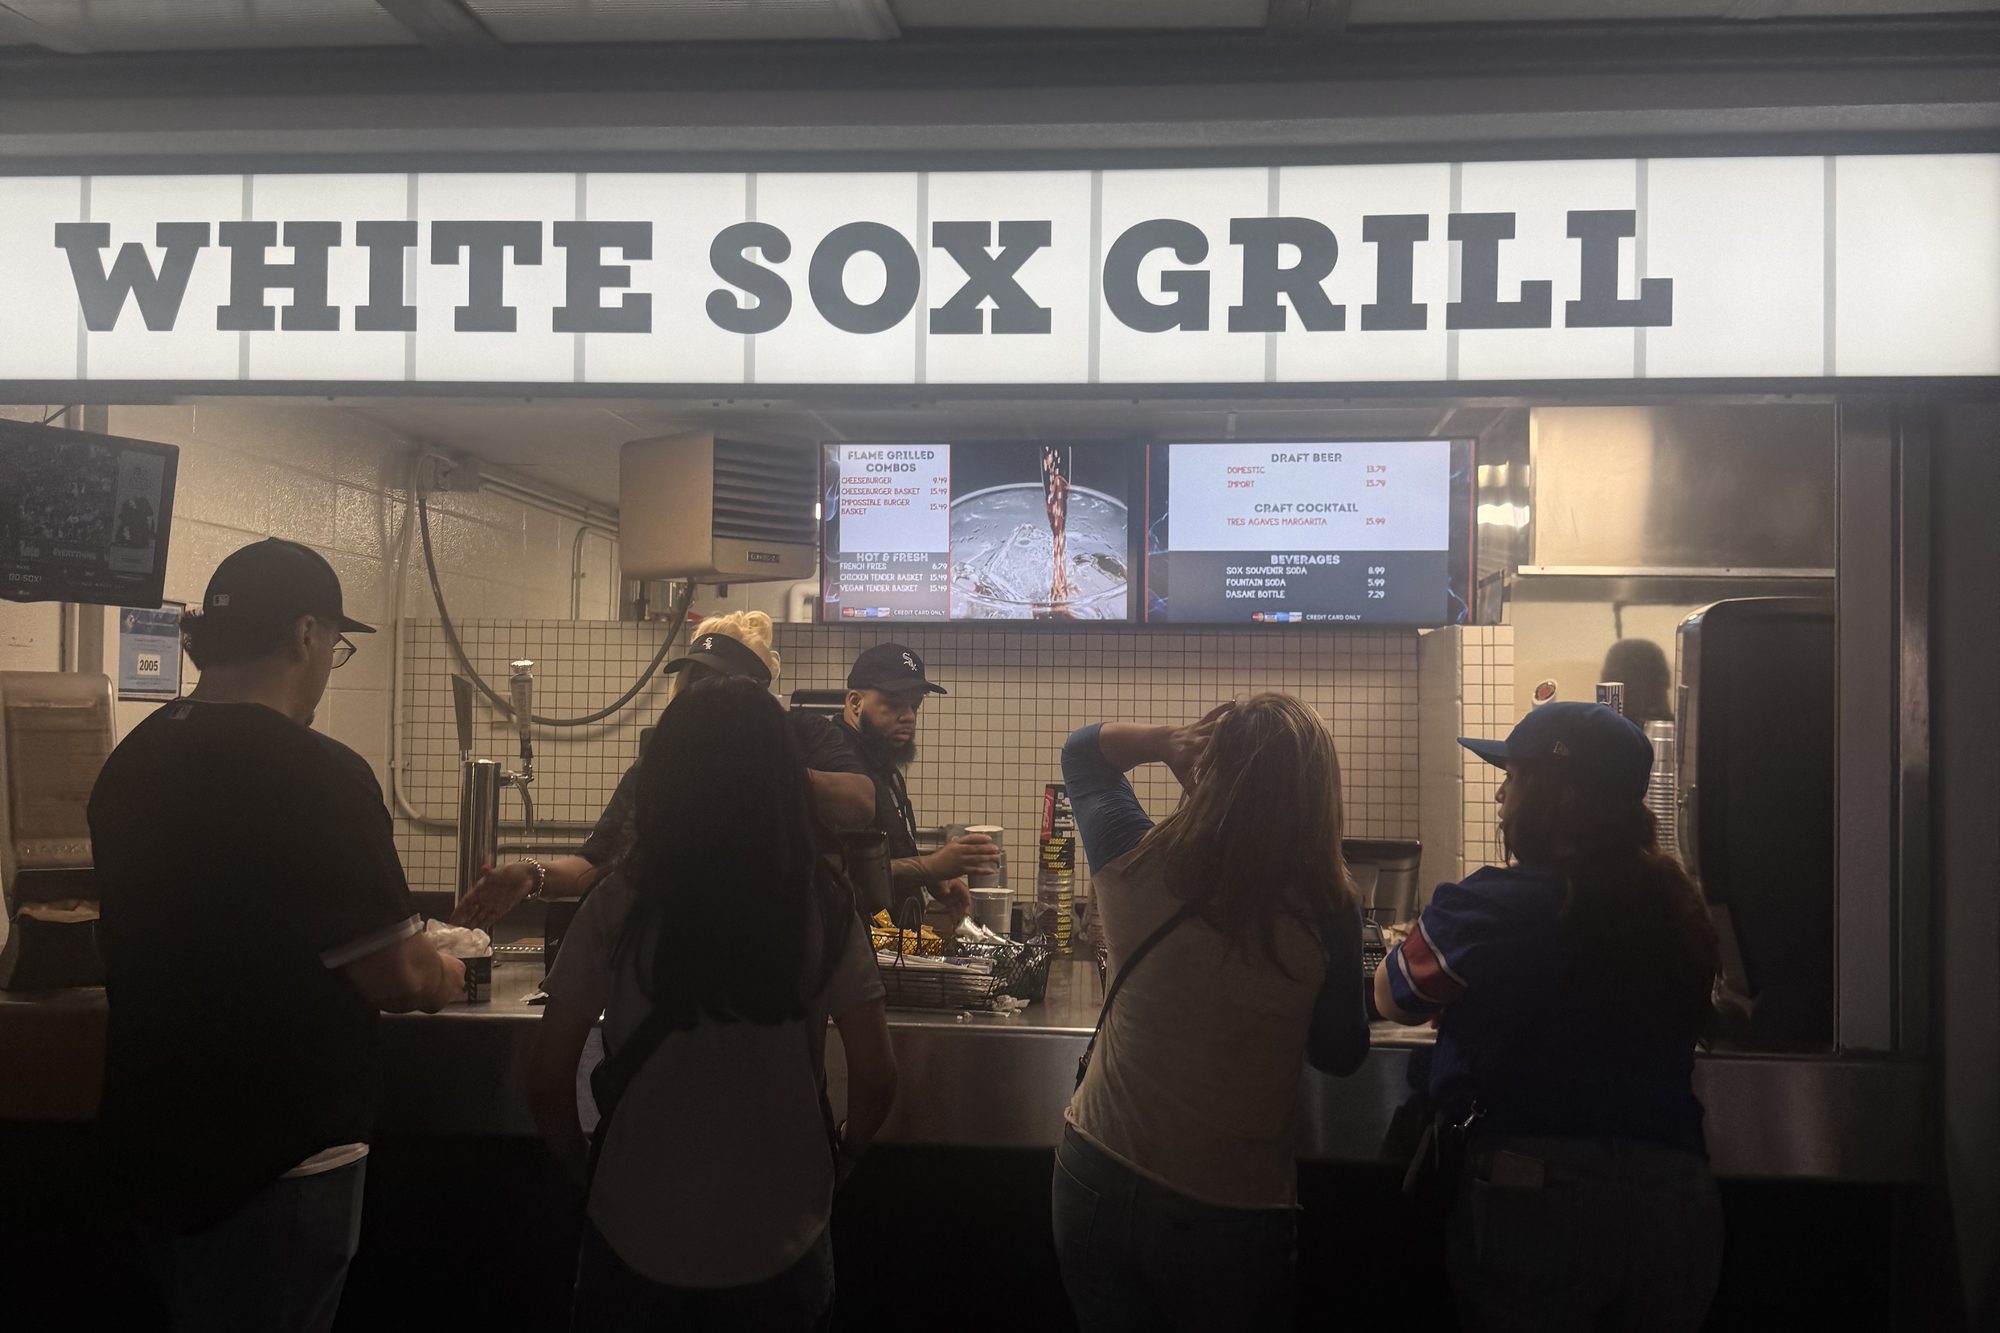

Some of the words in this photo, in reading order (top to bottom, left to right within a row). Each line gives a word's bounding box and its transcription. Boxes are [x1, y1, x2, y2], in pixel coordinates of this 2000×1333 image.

[54, 221, 653, 333] WHITE
[705, 220, 1053, 335] SOX
[1102, 209, 1673, 333] GRILL
[847, 450, 884, 460] FLAME
[886, 450, 935, 460] GRILLED
[1271, 453, 1310, 463] DRAFT
[1312, 452, 1342, 463] BEER
[866, 463, 917, 473] COMBOS
[1227, 466, 1265, 474] DOMESTIC
[841, 476, 892, 484] CHEESEBURGER
[1227, 480, 1255, 488] IMPORT
[894, 487, 920, 495] BASKET
[841, 498, 882, 506] IMPOSSIBLE
[841, 507, 867, 515] BASKET
[930, 503, 947, 511] 15.49
[1254, 503, 1293, 513] CRAFT
[1296, 503, 1359, 513] COCKTAIL
[1227, 518, 1246, 526] TRES
[1248, 518, 1280, 526] AGAVES
[1281, 518, 1328, 526] MARGARITA
[856, 552, 878, 562] HOT
[882, 552, 890, 562] &
[892, 552, 929, 562] FRESH
[1270, 555, 1341, 564] BEVERAGES
[840, 562, 865, 570] FRENCH
[866, 562, 887, 570] FRIES
[1226, 566, 1243, 574] SOX
[1245, 566, 1284, 574] SOUVENIR
[1285, 566, 1307, 574] SODA
[871, 573, 895, 581] TENDER
[897, 573, 923, 581] BASKET
[929, 573, 948, 581] 15.49
[1226, 578, 1263, 586] FOUNTAIN
[1264, 578, 1286, 586] SODA
[1226, 590, 1256, 598] DASANI
[1257, 590, 1285, 598] BOTTLE
[139, 659, 159, 672] 2005
